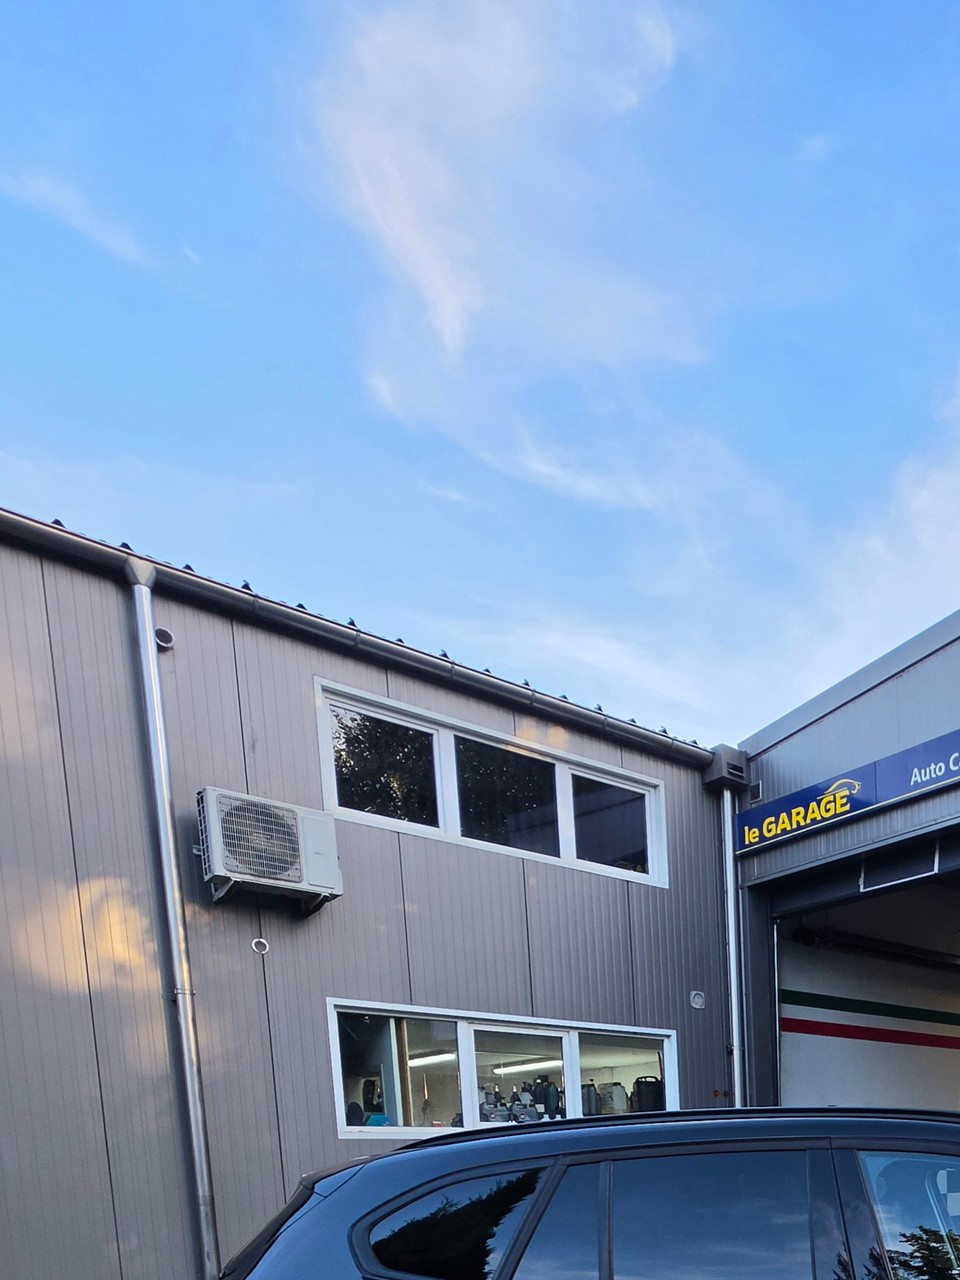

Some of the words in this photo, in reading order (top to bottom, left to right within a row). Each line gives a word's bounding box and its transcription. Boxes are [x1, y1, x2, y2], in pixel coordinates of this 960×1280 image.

[910, 762, 945, 786] Auto
[744, 825, 760, 845] le
[762, 789, 851, 838] GARAGE
